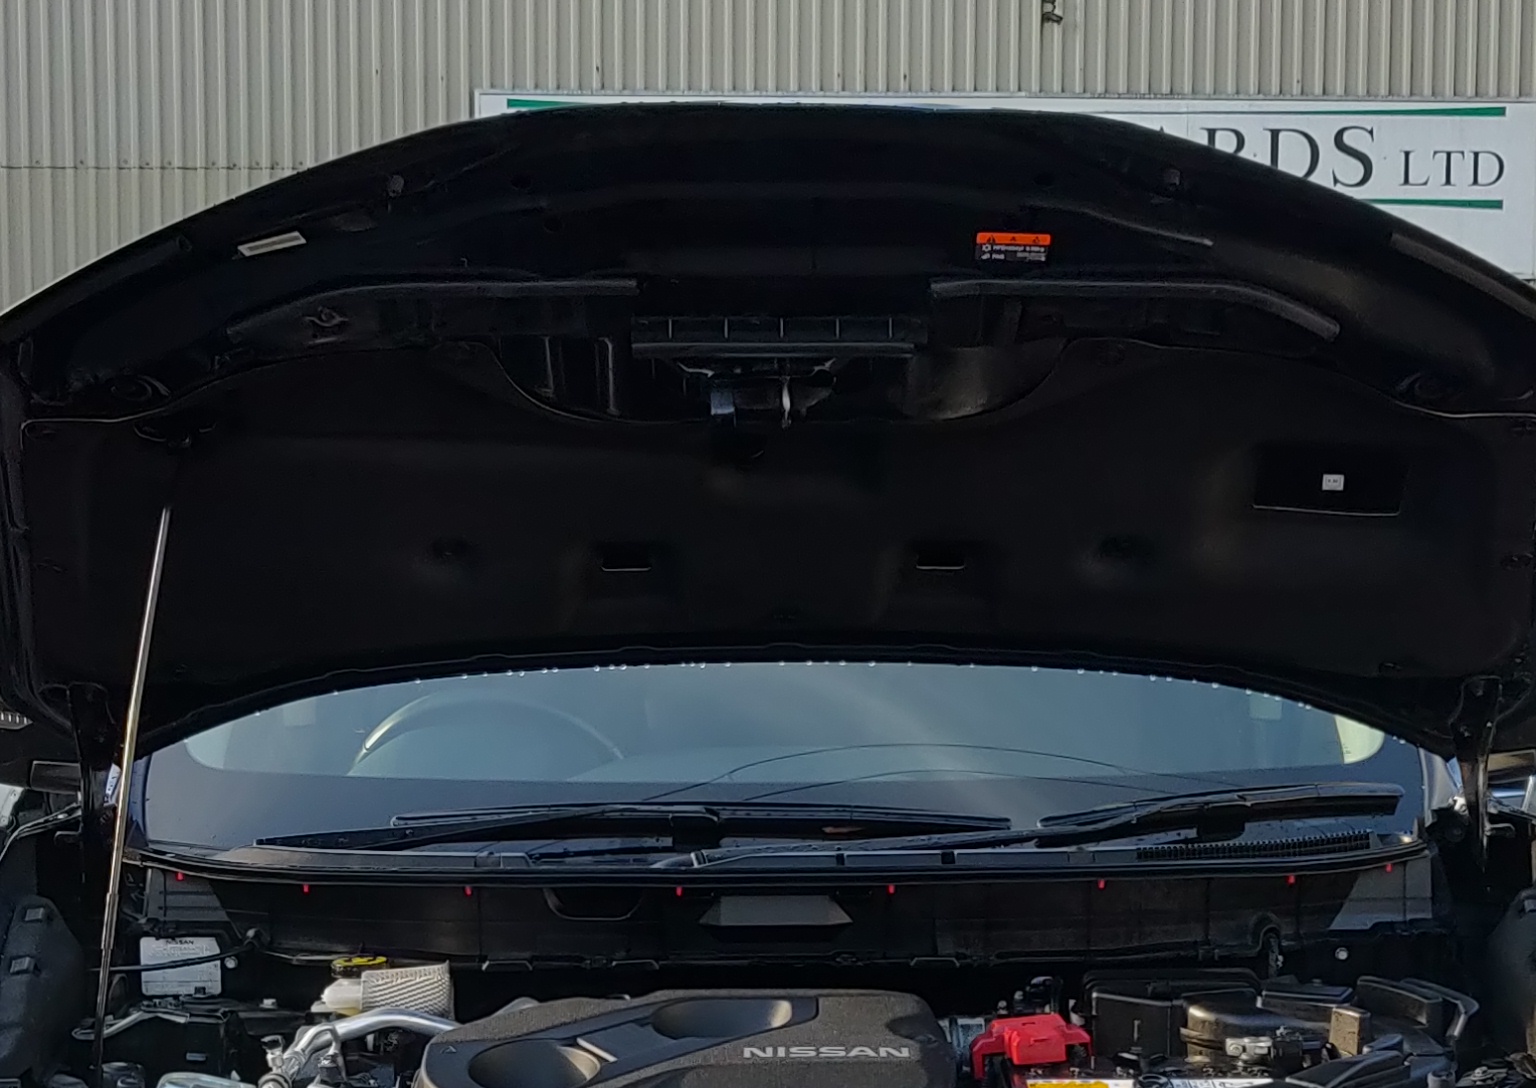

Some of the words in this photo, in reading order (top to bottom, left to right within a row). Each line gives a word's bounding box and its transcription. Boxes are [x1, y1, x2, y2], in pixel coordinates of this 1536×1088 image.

[1158, 125, 1375, 188] DS
[1398, 150, 1505, 187] LTD
[743, 1046, 910, 1058] NISSAN
